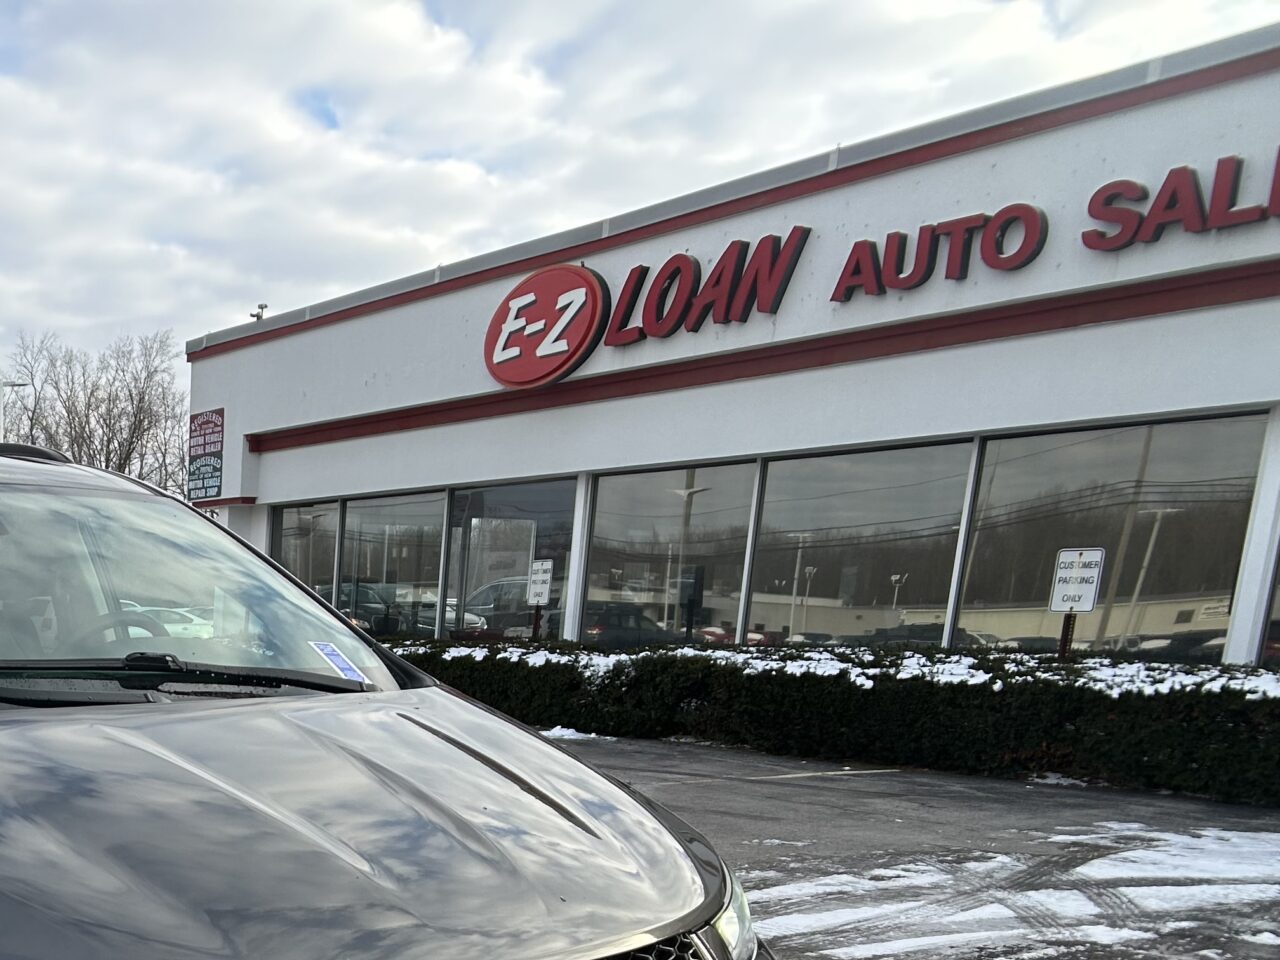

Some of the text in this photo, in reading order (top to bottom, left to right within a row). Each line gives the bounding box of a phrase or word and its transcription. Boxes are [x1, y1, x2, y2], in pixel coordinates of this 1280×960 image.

[493, 145, 1280, 364] E-Z LOAN AUTO SAL
[191, 411, 222, 430] REGISTERED
[190, 456, 221, 472] REGISTERED
[204, 477, 221, 487] VEHICLE
[190, 486, 218, 499] REPAIR SHOP
[1062, 594, 1083, 603] ONLY
